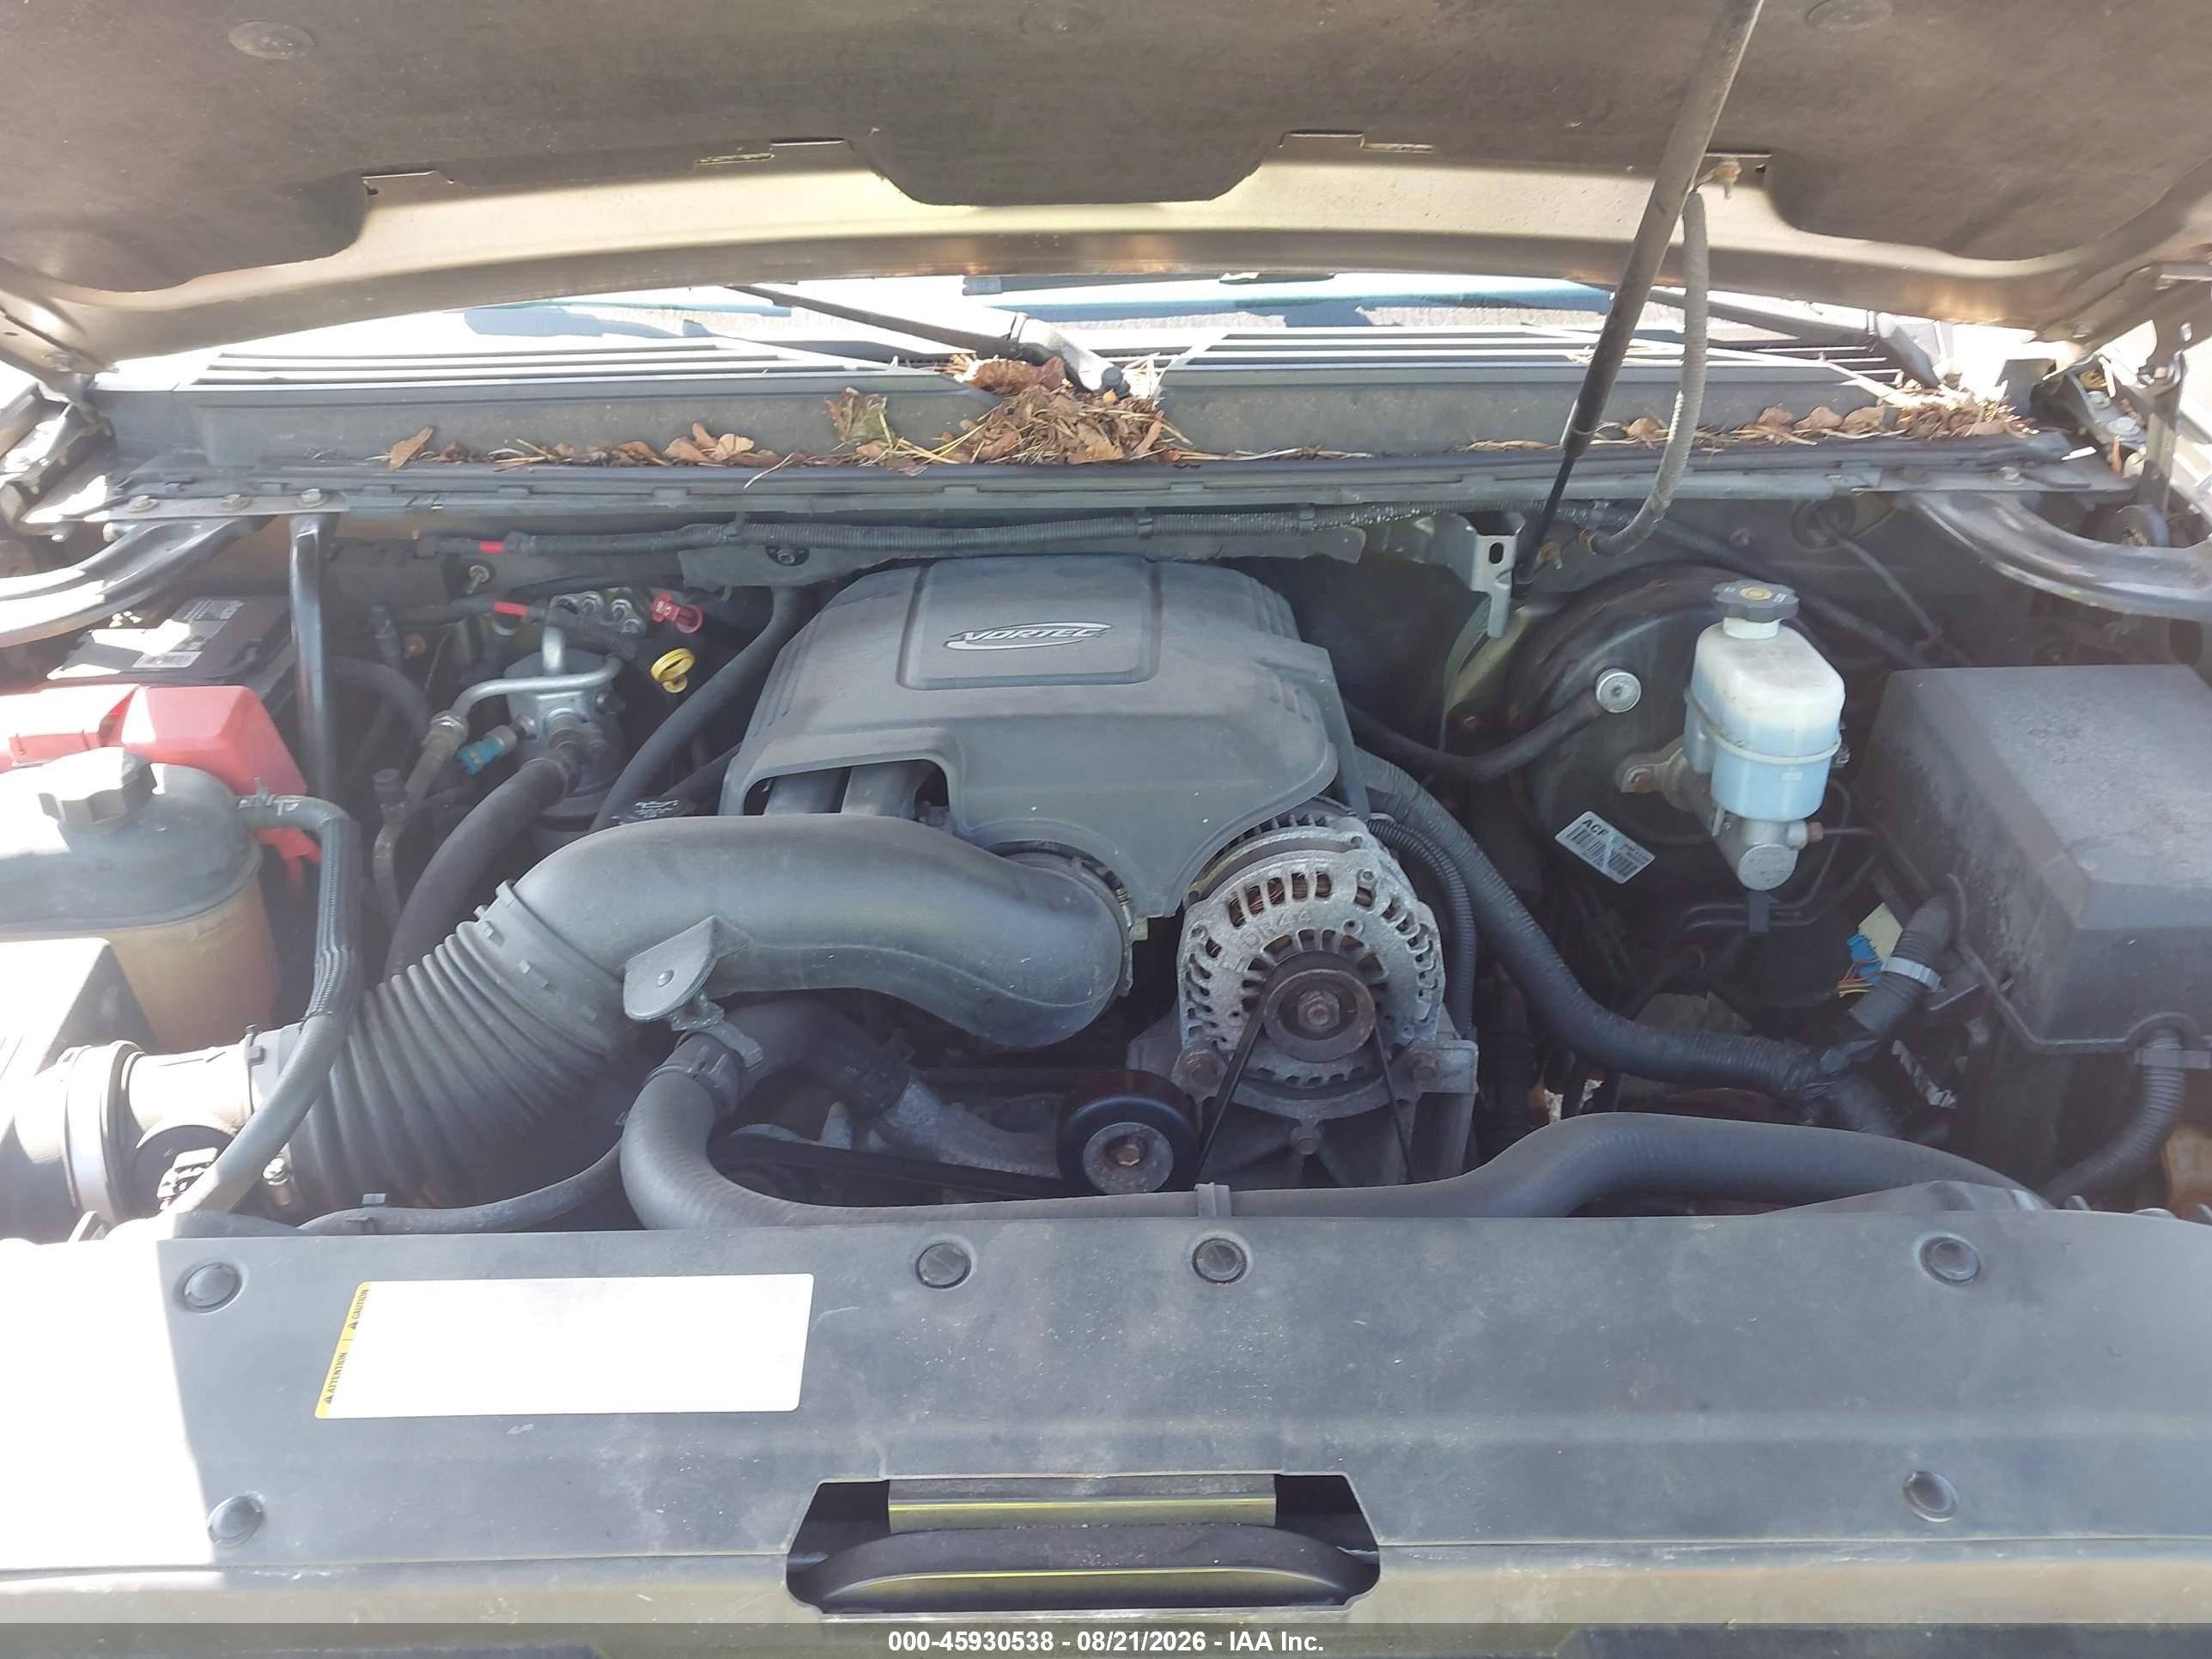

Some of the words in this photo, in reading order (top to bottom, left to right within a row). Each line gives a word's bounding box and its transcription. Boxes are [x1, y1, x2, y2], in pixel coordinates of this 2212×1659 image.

[957, 627, 1104, 641] VORTEC
[351, 1289, 369, 1320] CAUTION
[327, 1352, 348, 1394] ATTENTION
